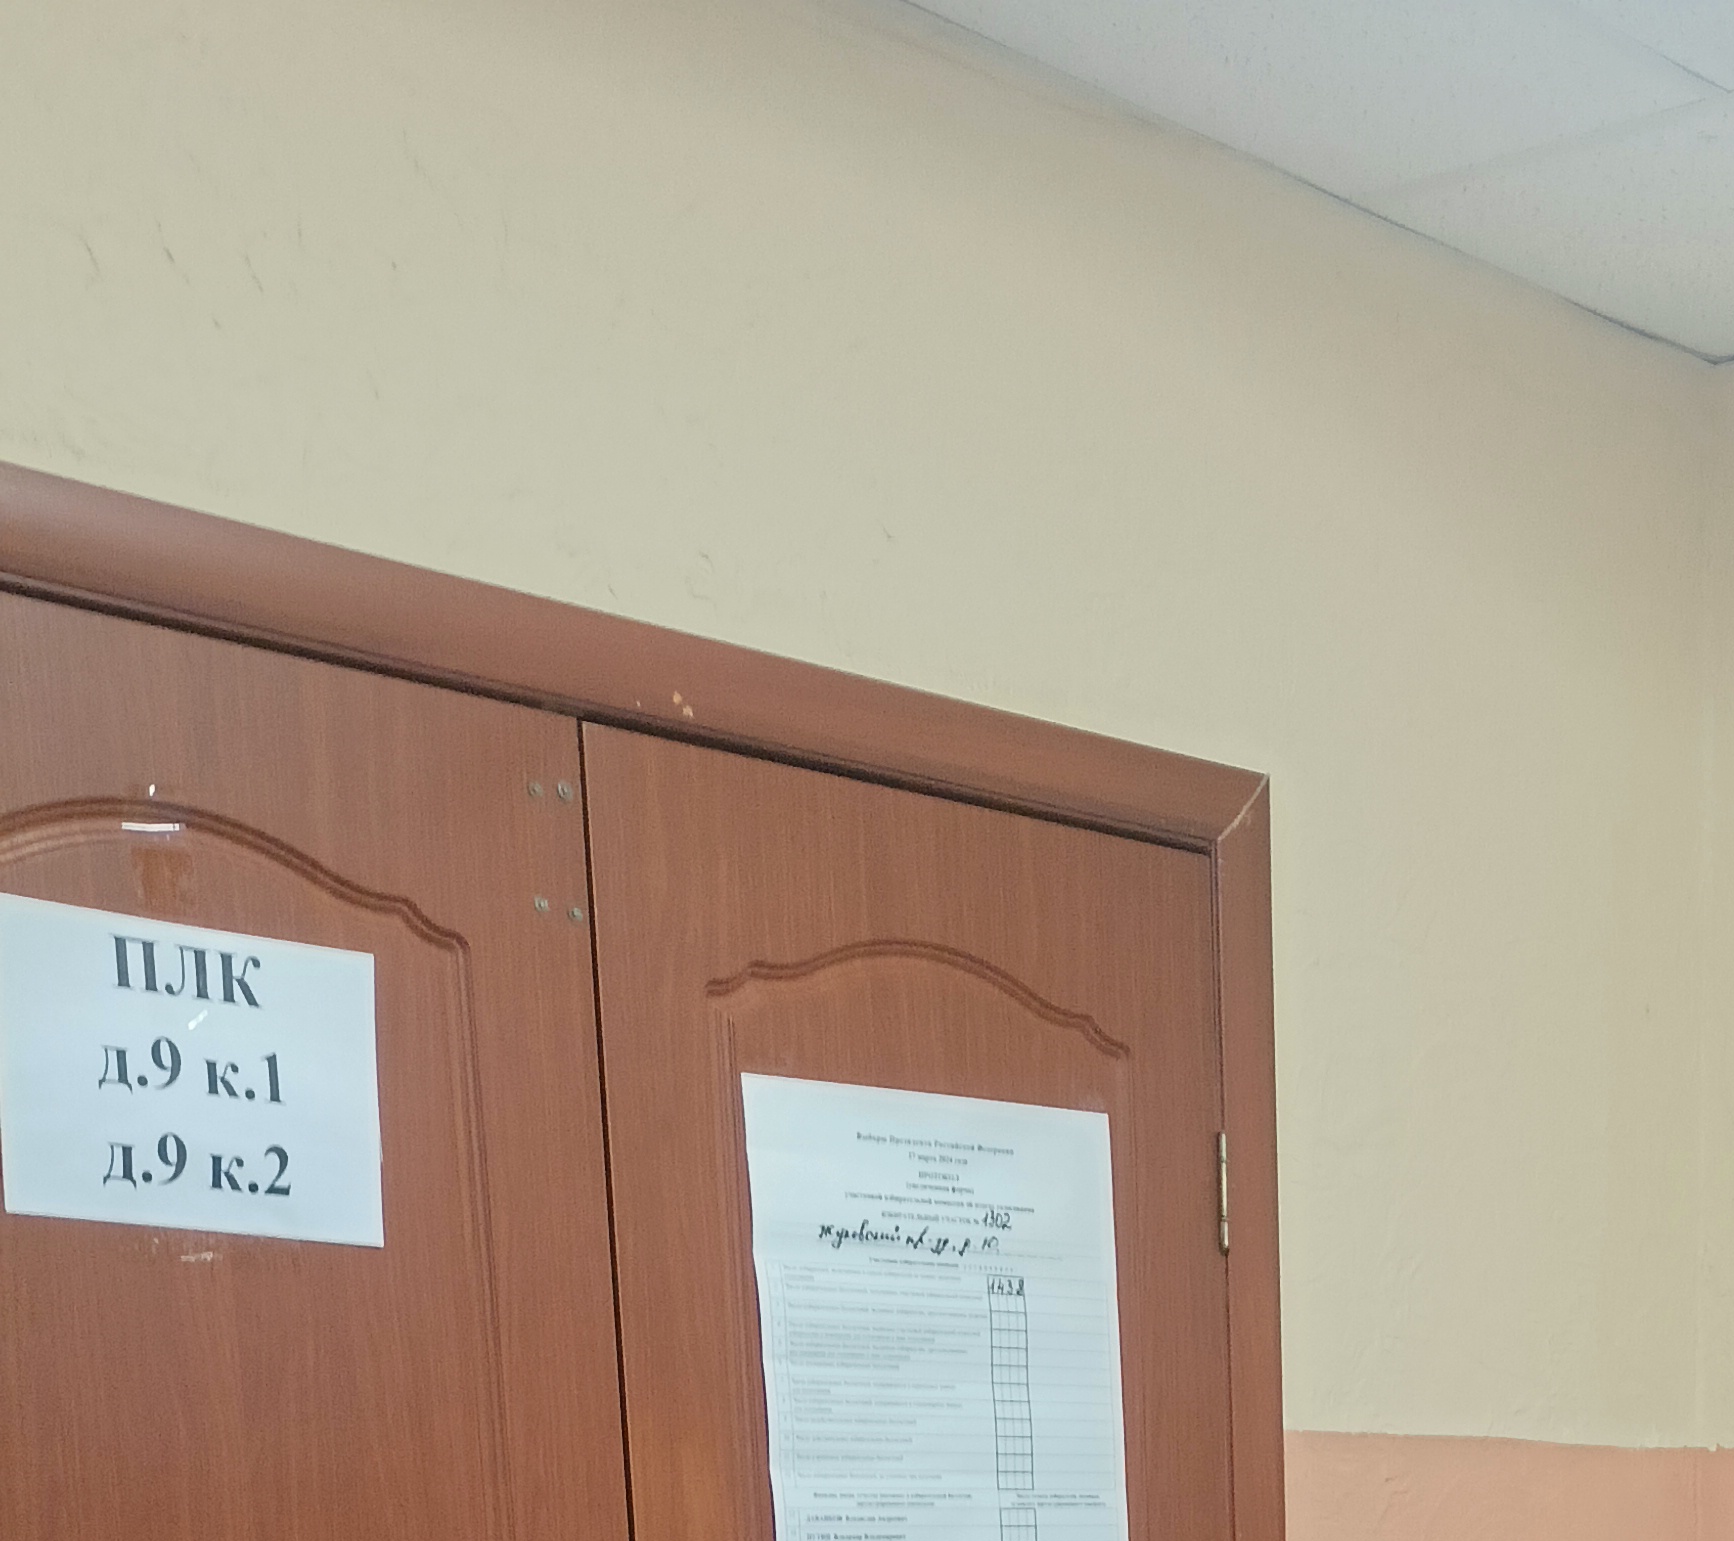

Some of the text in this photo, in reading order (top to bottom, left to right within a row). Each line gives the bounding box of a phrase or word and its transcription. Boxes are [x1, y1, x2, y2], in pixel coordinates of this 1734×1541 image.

[112, 934, 262, 1009] ПЛК
[98, 1035, 286, 1106] д.9 к.1
[102, 1131, 293, 1197] д.9 к.2
